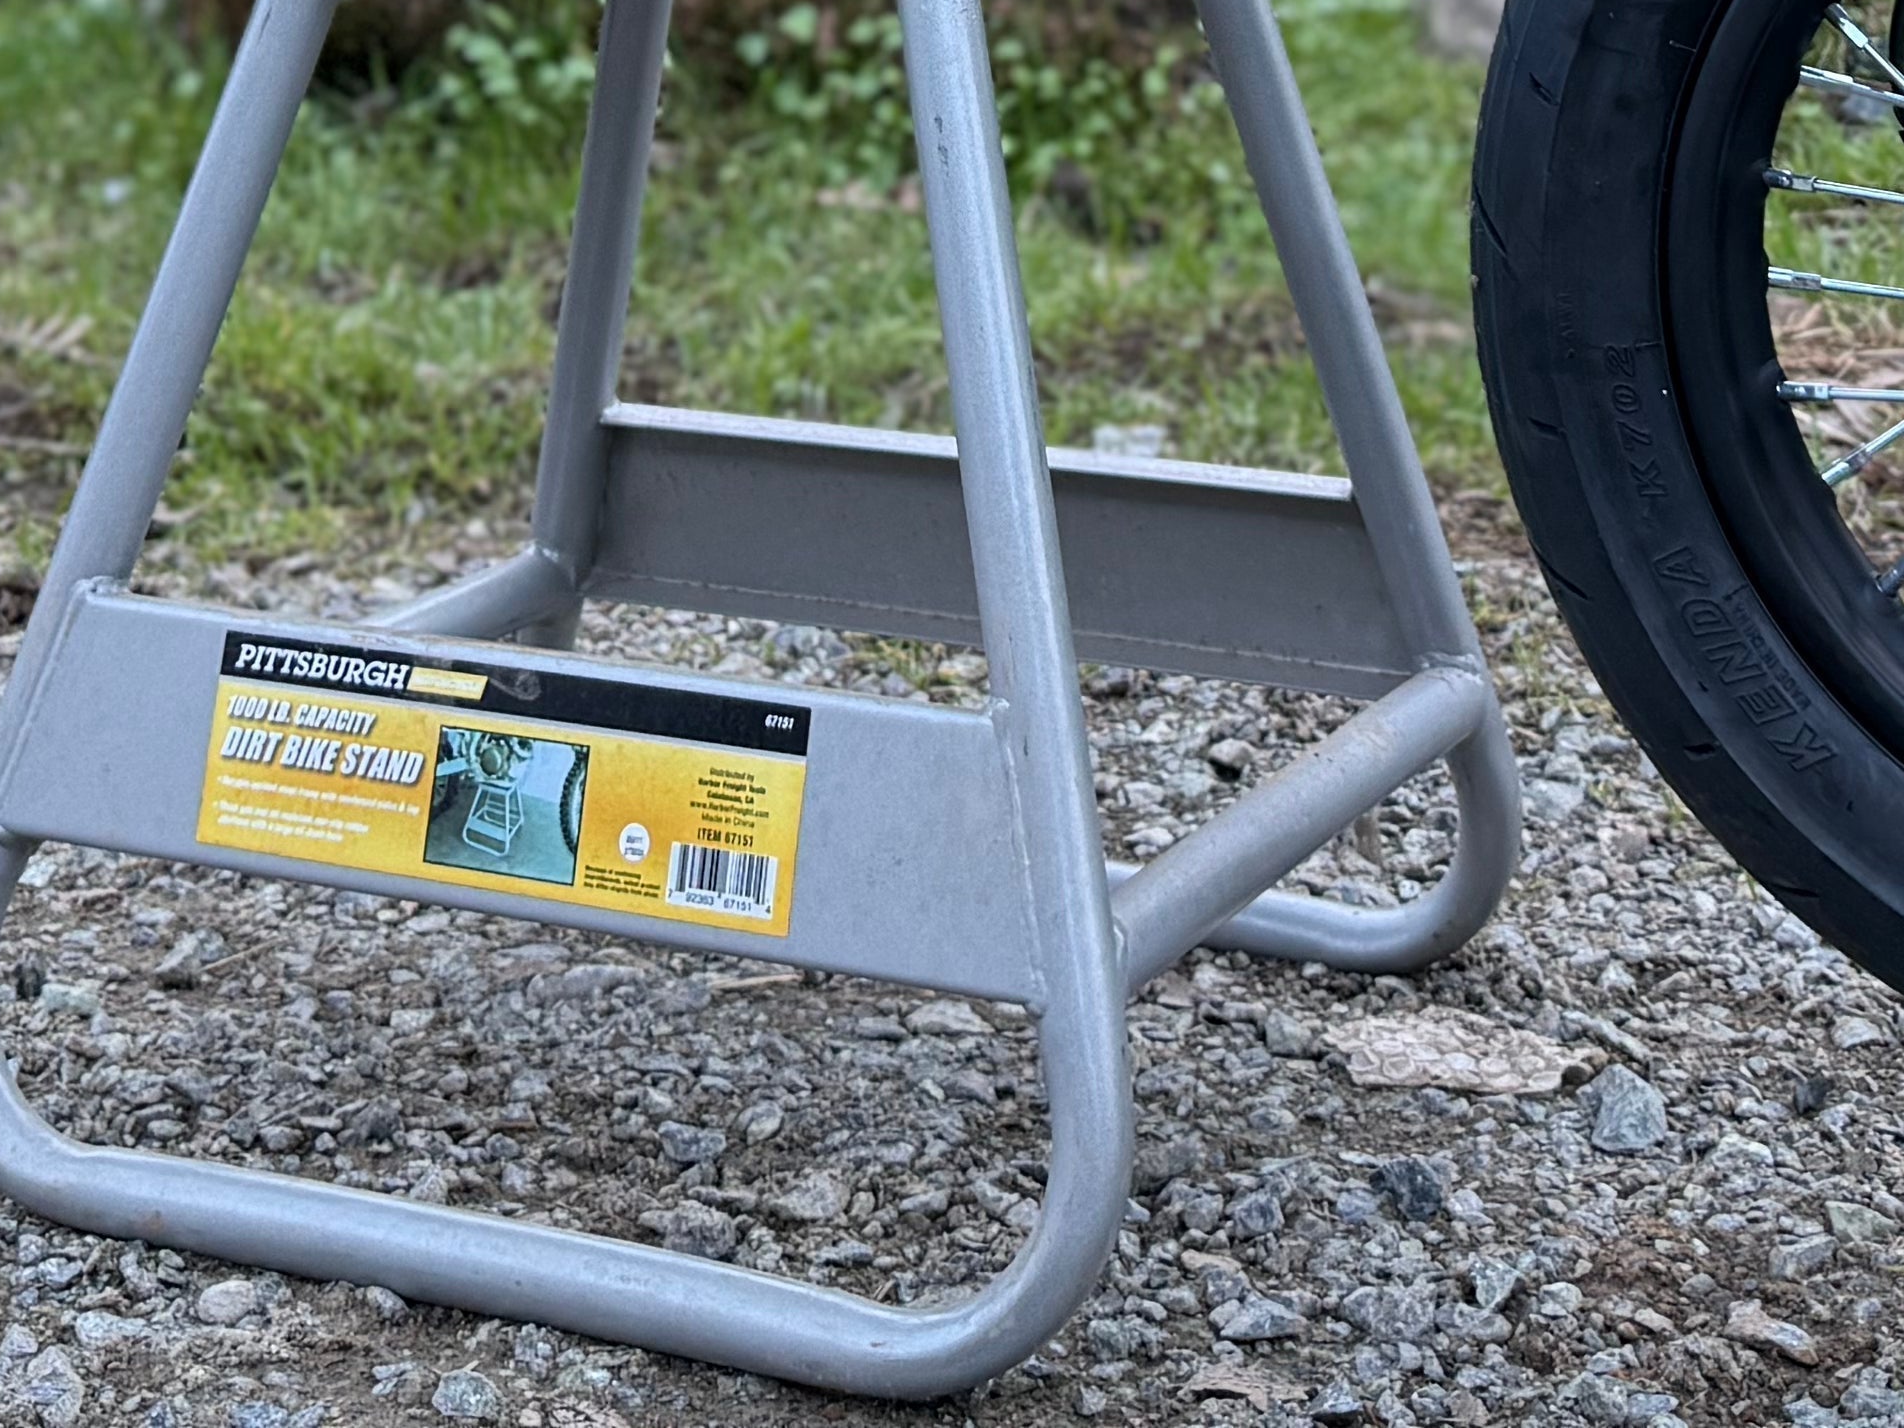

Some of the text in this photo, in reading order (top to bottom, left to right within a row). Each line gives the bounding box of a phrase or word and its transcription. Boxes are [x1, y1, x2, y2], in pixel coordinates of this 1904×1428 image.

[1607, 346, 1838, 772] KENDA K702
[235, 643, 411, 691] PITTSBURGH
[227, 695, 376, 736] 1000 LB. CAPACITY
[765, 713, 795, 731] 67151
[221, 725, 425, 785] DIRT BIKE STAND
[697, 827, 755, 848] ITEM 67151
